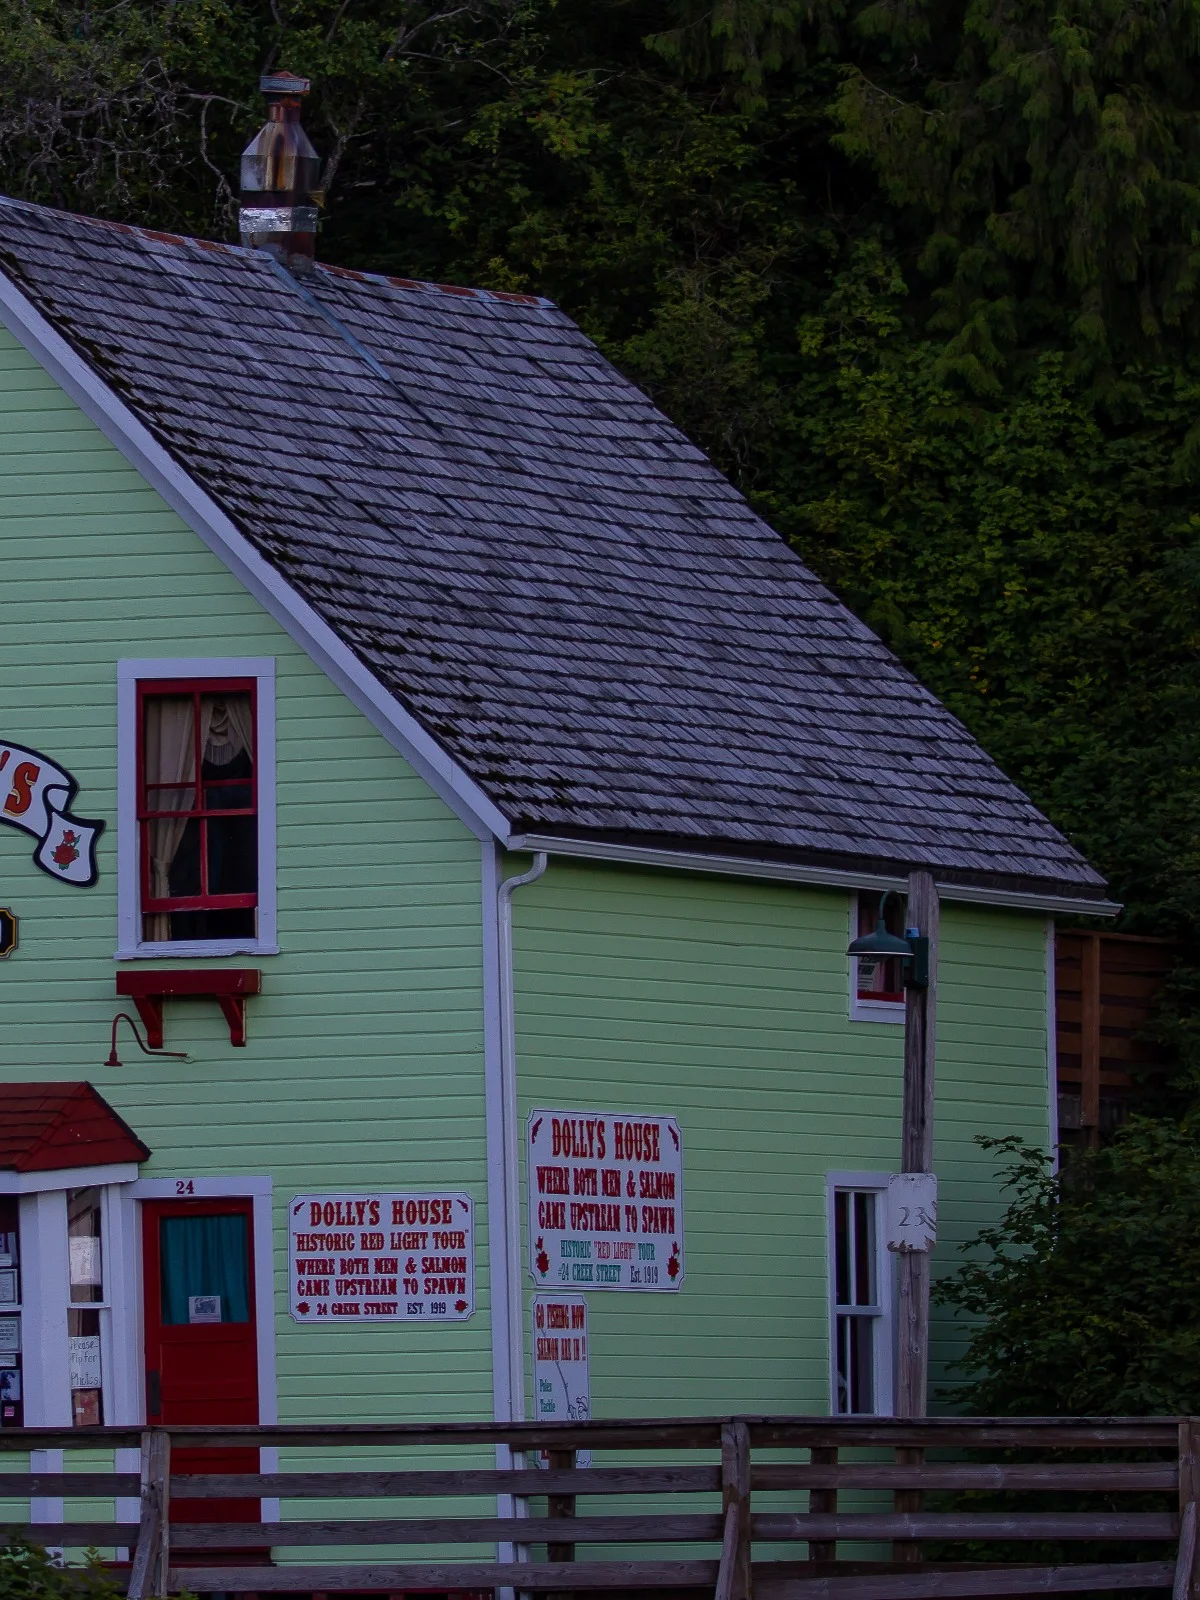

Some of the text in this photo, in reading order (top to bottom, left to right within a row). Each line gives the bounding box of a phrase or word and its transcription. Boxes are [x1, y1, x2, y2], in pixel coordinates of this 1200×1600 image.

[551, 1117, 660, 1163] DOLLY'S HOUSE
[176, 1180, 194, 1194] 24
[536, 1166, 675, 1200] WHERE BOTH MEN & SALMON
[310, 1199, 452, 1226] DOLLY'S HOUSE
[538, 1201, 675, 1234] CAME UPSTREAM TO SPAWN
[898, 1206, 925, 1227] 23
[360, 1232, 385, 1250] RED
[390, 1232, 429, 1250] LIGHT
[560, 1240, 591, 1258] HISTORIC
[638, 1243, 655, 1260] TOUR
[295, 1256, 467, 1275] WHERE BOTH MEN & SALMON
[572, 1264, 593, 1281] CREEK
[596, 1264, 621, 1282] STREET
[644, 1266, 658, 1283] 1919
[297, 1277, 466, 1296] CAME UPSTREAM TO SPAWN
[317, 1302, 447, 1315] 24 CREEK STREET EST. 1919
